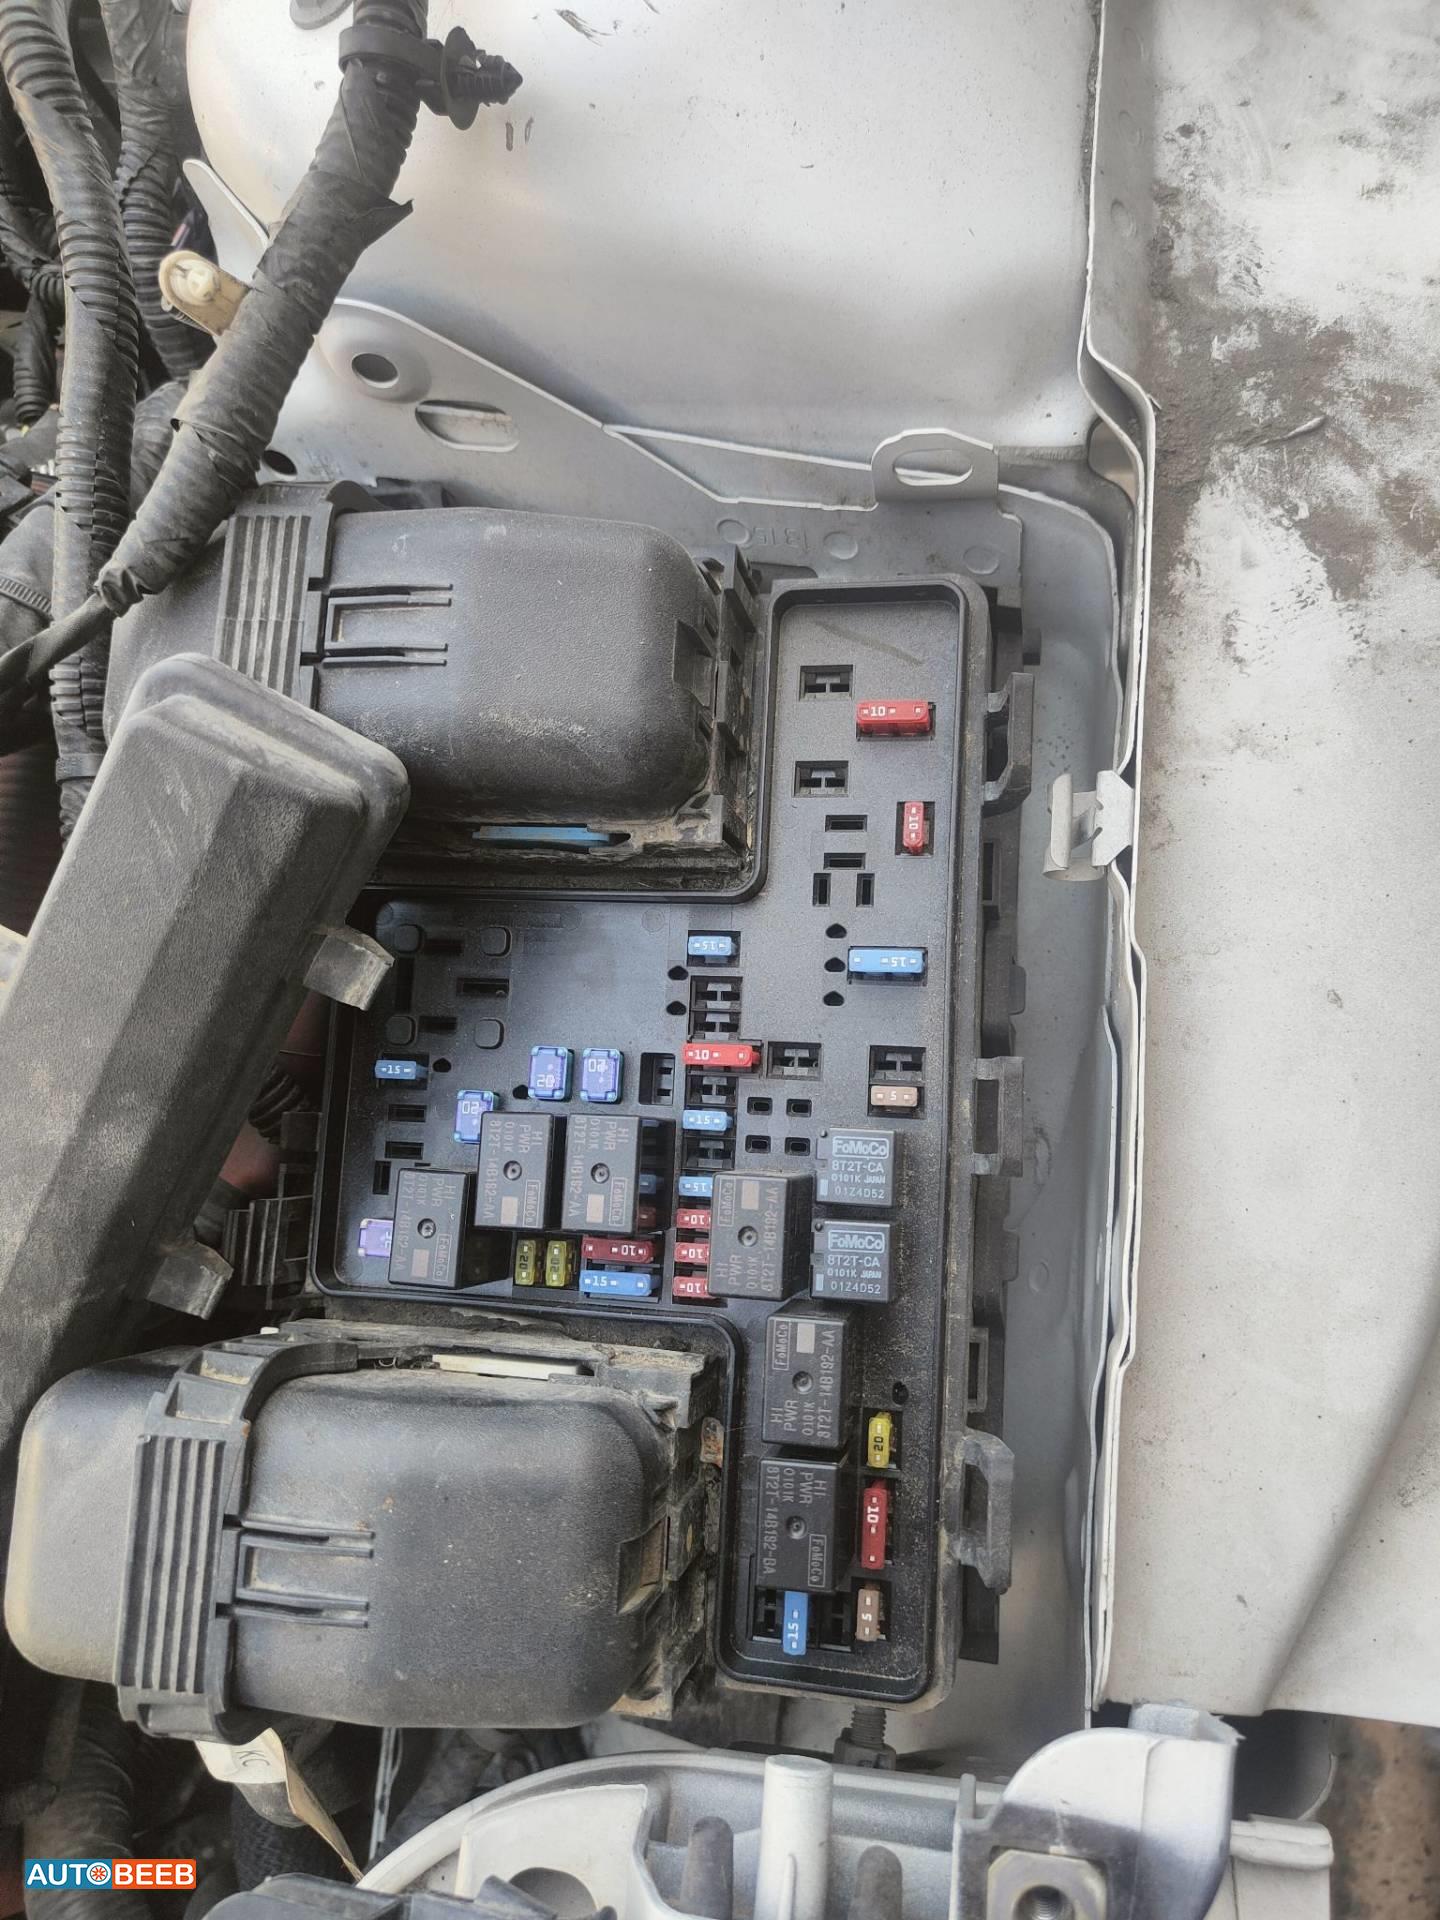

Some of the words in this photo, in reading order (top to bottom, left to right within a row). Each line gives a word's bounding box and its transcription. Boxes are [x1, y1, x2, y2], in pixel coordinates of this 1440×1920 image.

[870, 706, 886, 716] 10
[908, 815, 918, 830] 10
[891, 956, 906, 967] 15
[695, 1049, 709, 1061] 10
[388, 1065, 400, 1074] 15
[890, 1090, 897, 1101] 5
[696, 1115, 710, 1124] 15
[518, 1125, 530, 1153] PWR
[532, 1131, 543, 1145] HI
[604, 1121, 616, 1151] PWR
[618, 1128, 629, 1142] HI
[834, 1139, 887, 1155] FoMoCo
[832, 1161, 884, 1173] 8T2T-CA
[864, 1175, 885, 1184] JAPAN
[693, 1183, 706, 1192] 15
[691, 1215, 704, 1224] 10
[830, 1234, 883, 1249] FoMoCo
[621, 1245, 636, 1256] 10
[689, 1249, 702, 1258] 10
[520, 1255, 528, 1269] 20
[828, 1255, 880, 1267] 8T2T-CA
[729, 1254, 742, 1286] PWR
[861, 1269, 881, 1278] JAPAN
[593, 1276, 607, 1287] 15
[687, 1283, 700, 1293] 10
[776, 1324, 787, 1365] FoMoCo
[770, 1407, 783, 1423] HI
[784, 1399, 798, 1431] PWR
[873, 1436, 884, 1452] 20
[799, 1472, 813, 1504] PWR
[814, 1480, 827, 1496] HI
[867, 1506, 879, 1523] 10
[810, 1539, 823, 1582] FoMoCo
[862, 1612, 872, 1622] 5
[787, 1622, 798, 1639] 15
